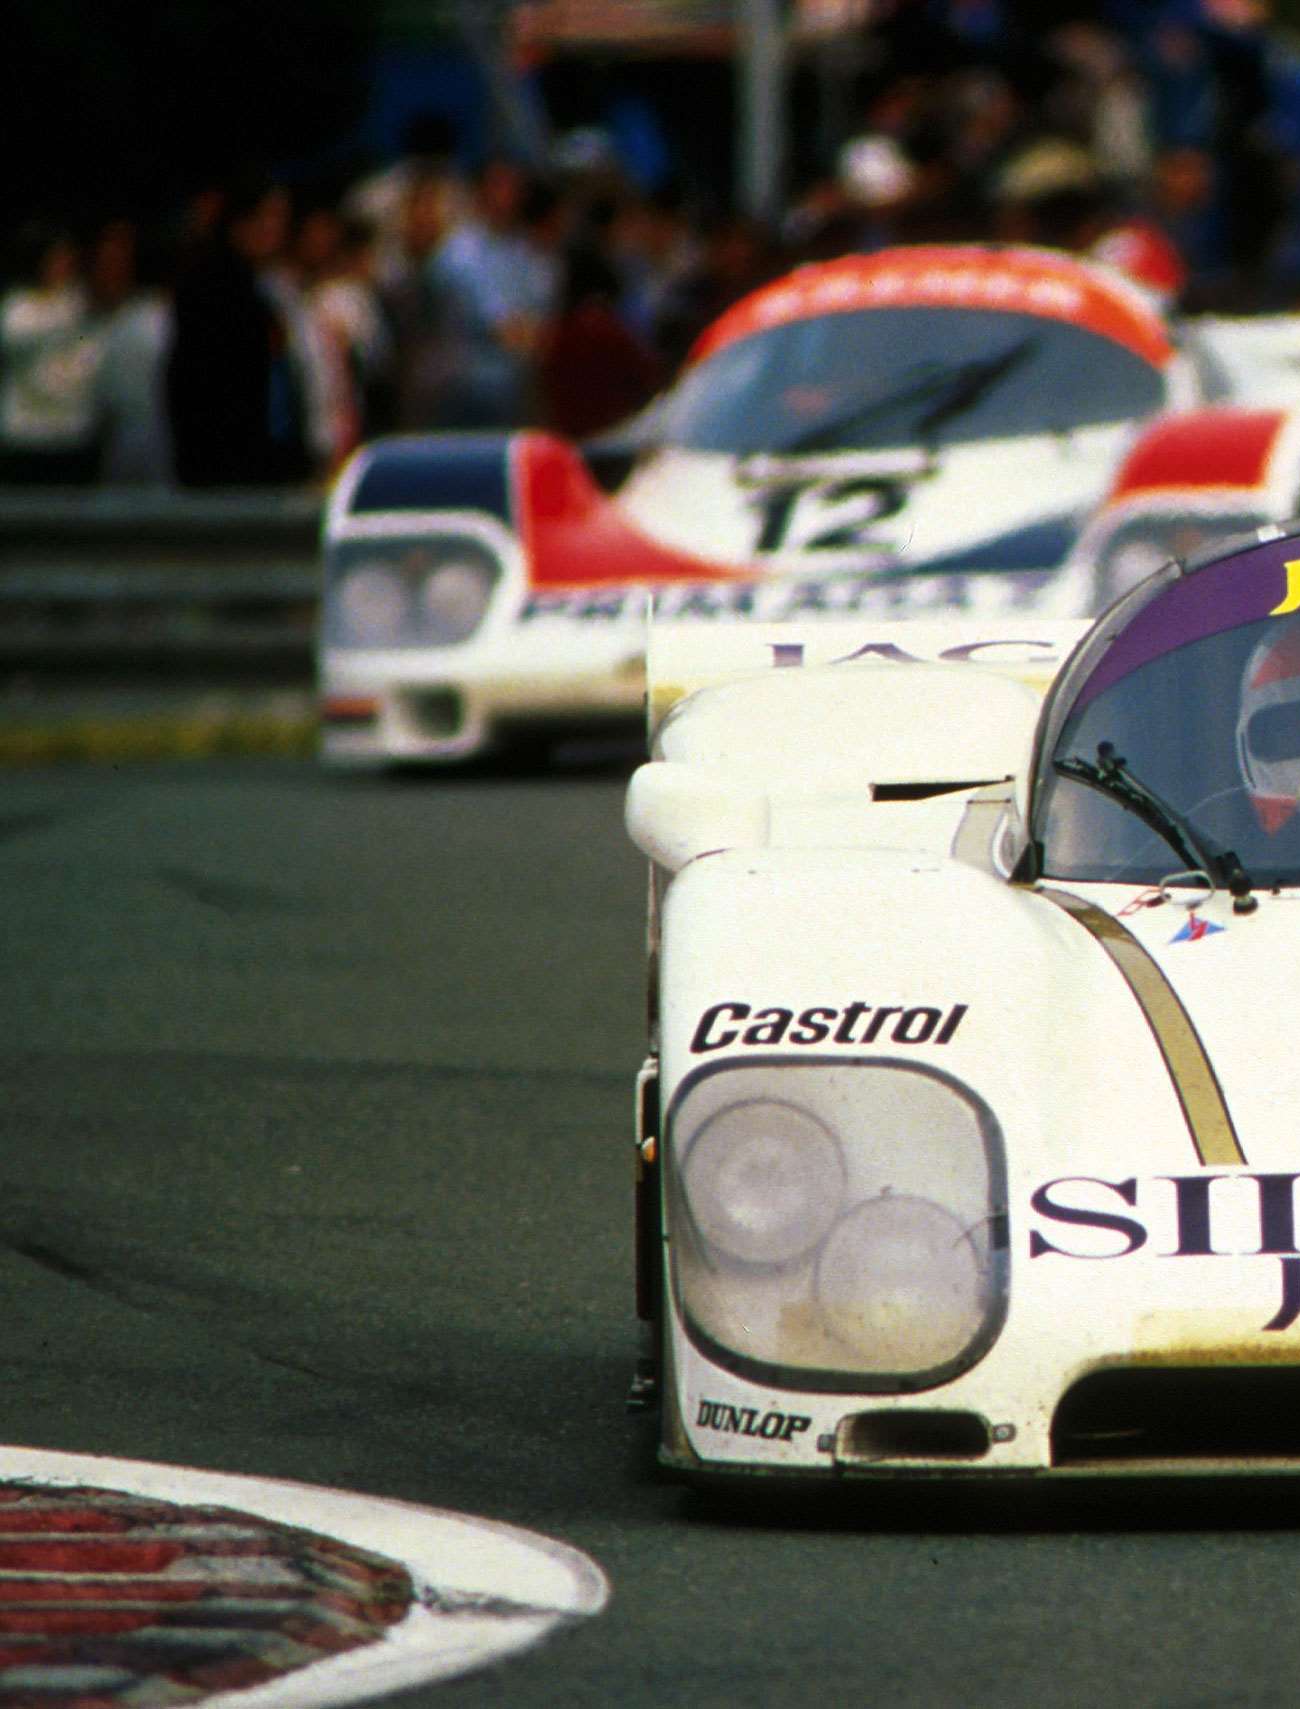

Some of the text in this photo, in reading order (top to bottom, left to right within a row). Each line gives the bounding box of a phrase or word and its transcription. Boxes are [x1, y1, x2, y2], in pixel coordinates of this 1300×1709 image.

[750, 474, 909, 553] 12
[691, 1002, 968, 1054] Castrol
[696, 1399, 813, 1442] DUNLOP
